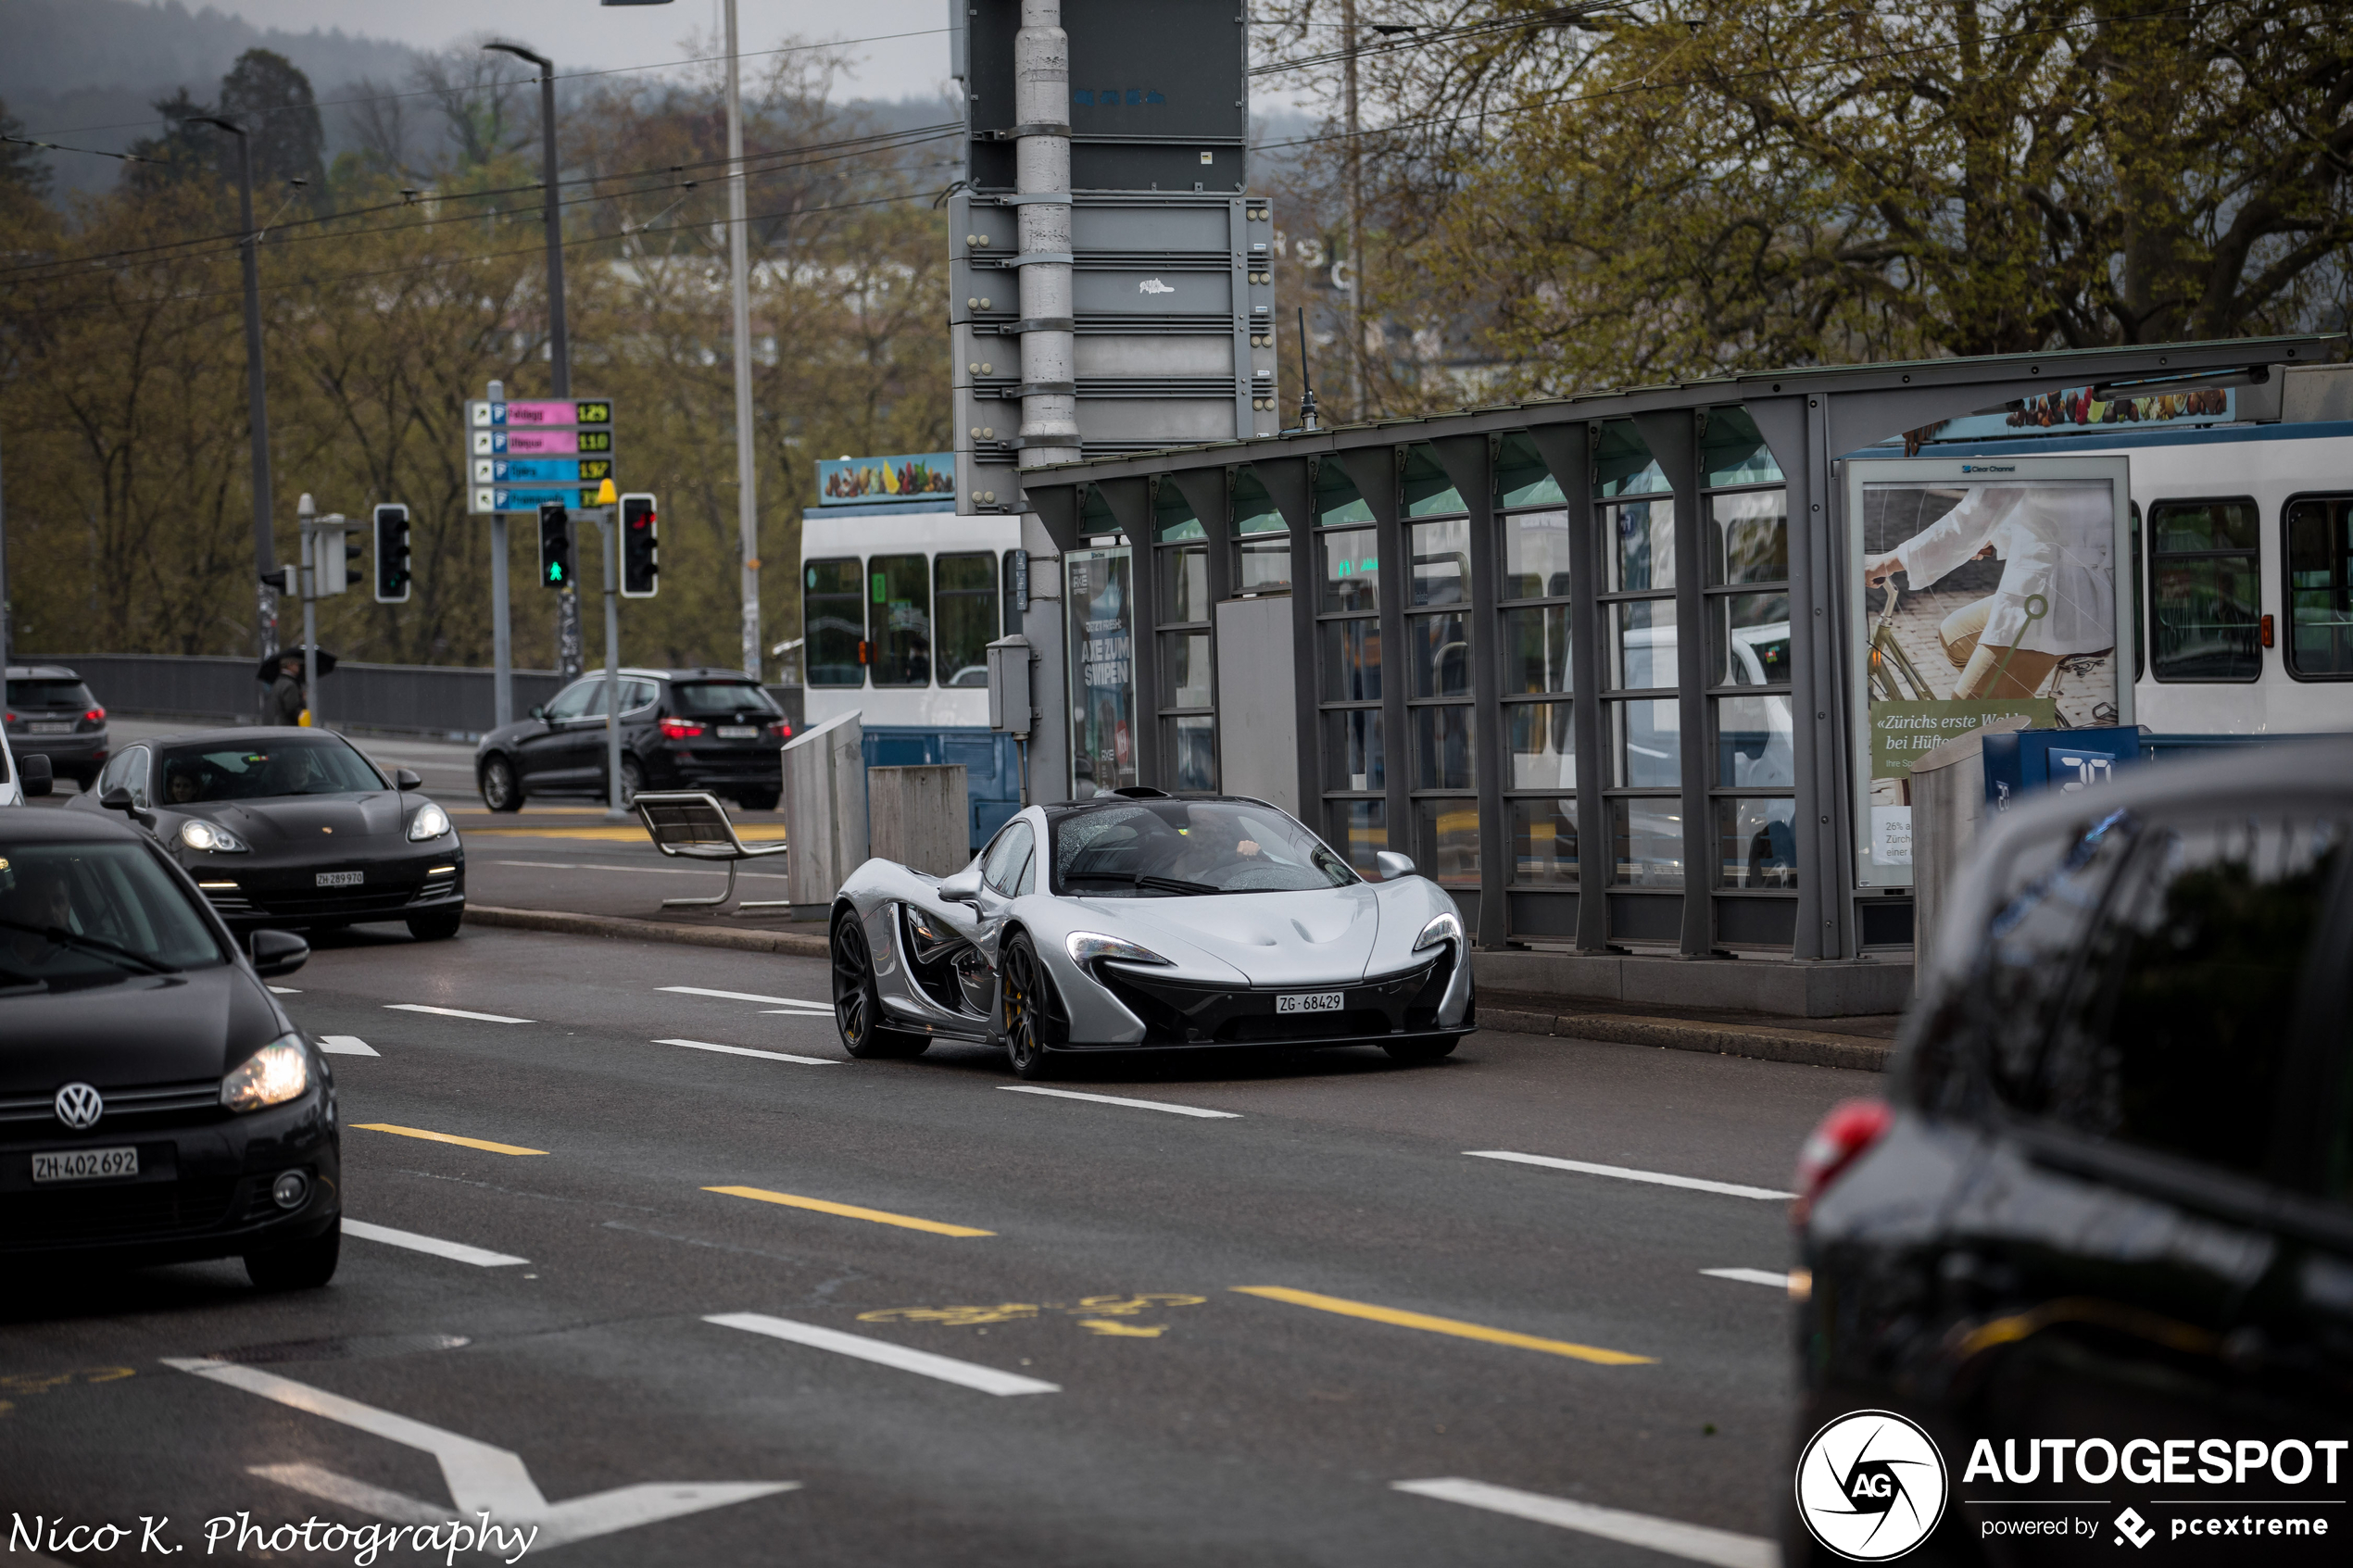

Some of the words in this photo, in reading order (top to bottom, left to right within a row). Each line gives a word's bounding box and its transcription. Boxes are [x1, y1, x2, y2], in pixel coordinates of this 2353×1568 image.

[1086, 619, 1103, 633] JETZT
[1081, 639, 1103, 663] AXE
[1104, 636, 1130, 660] ZUM
[1085, 660, 1128, 686] SWIPEN
[1877, 714, 1938, 730] «Zürichs
[1941, 717, 1976, 729] erste
[1885, 735, 1908, 749] bei
[1885, 759, 1901, 768] Ihre
[1885, 822, 1904, 831] 26%
[1886, 848, 1908, 857] einer
